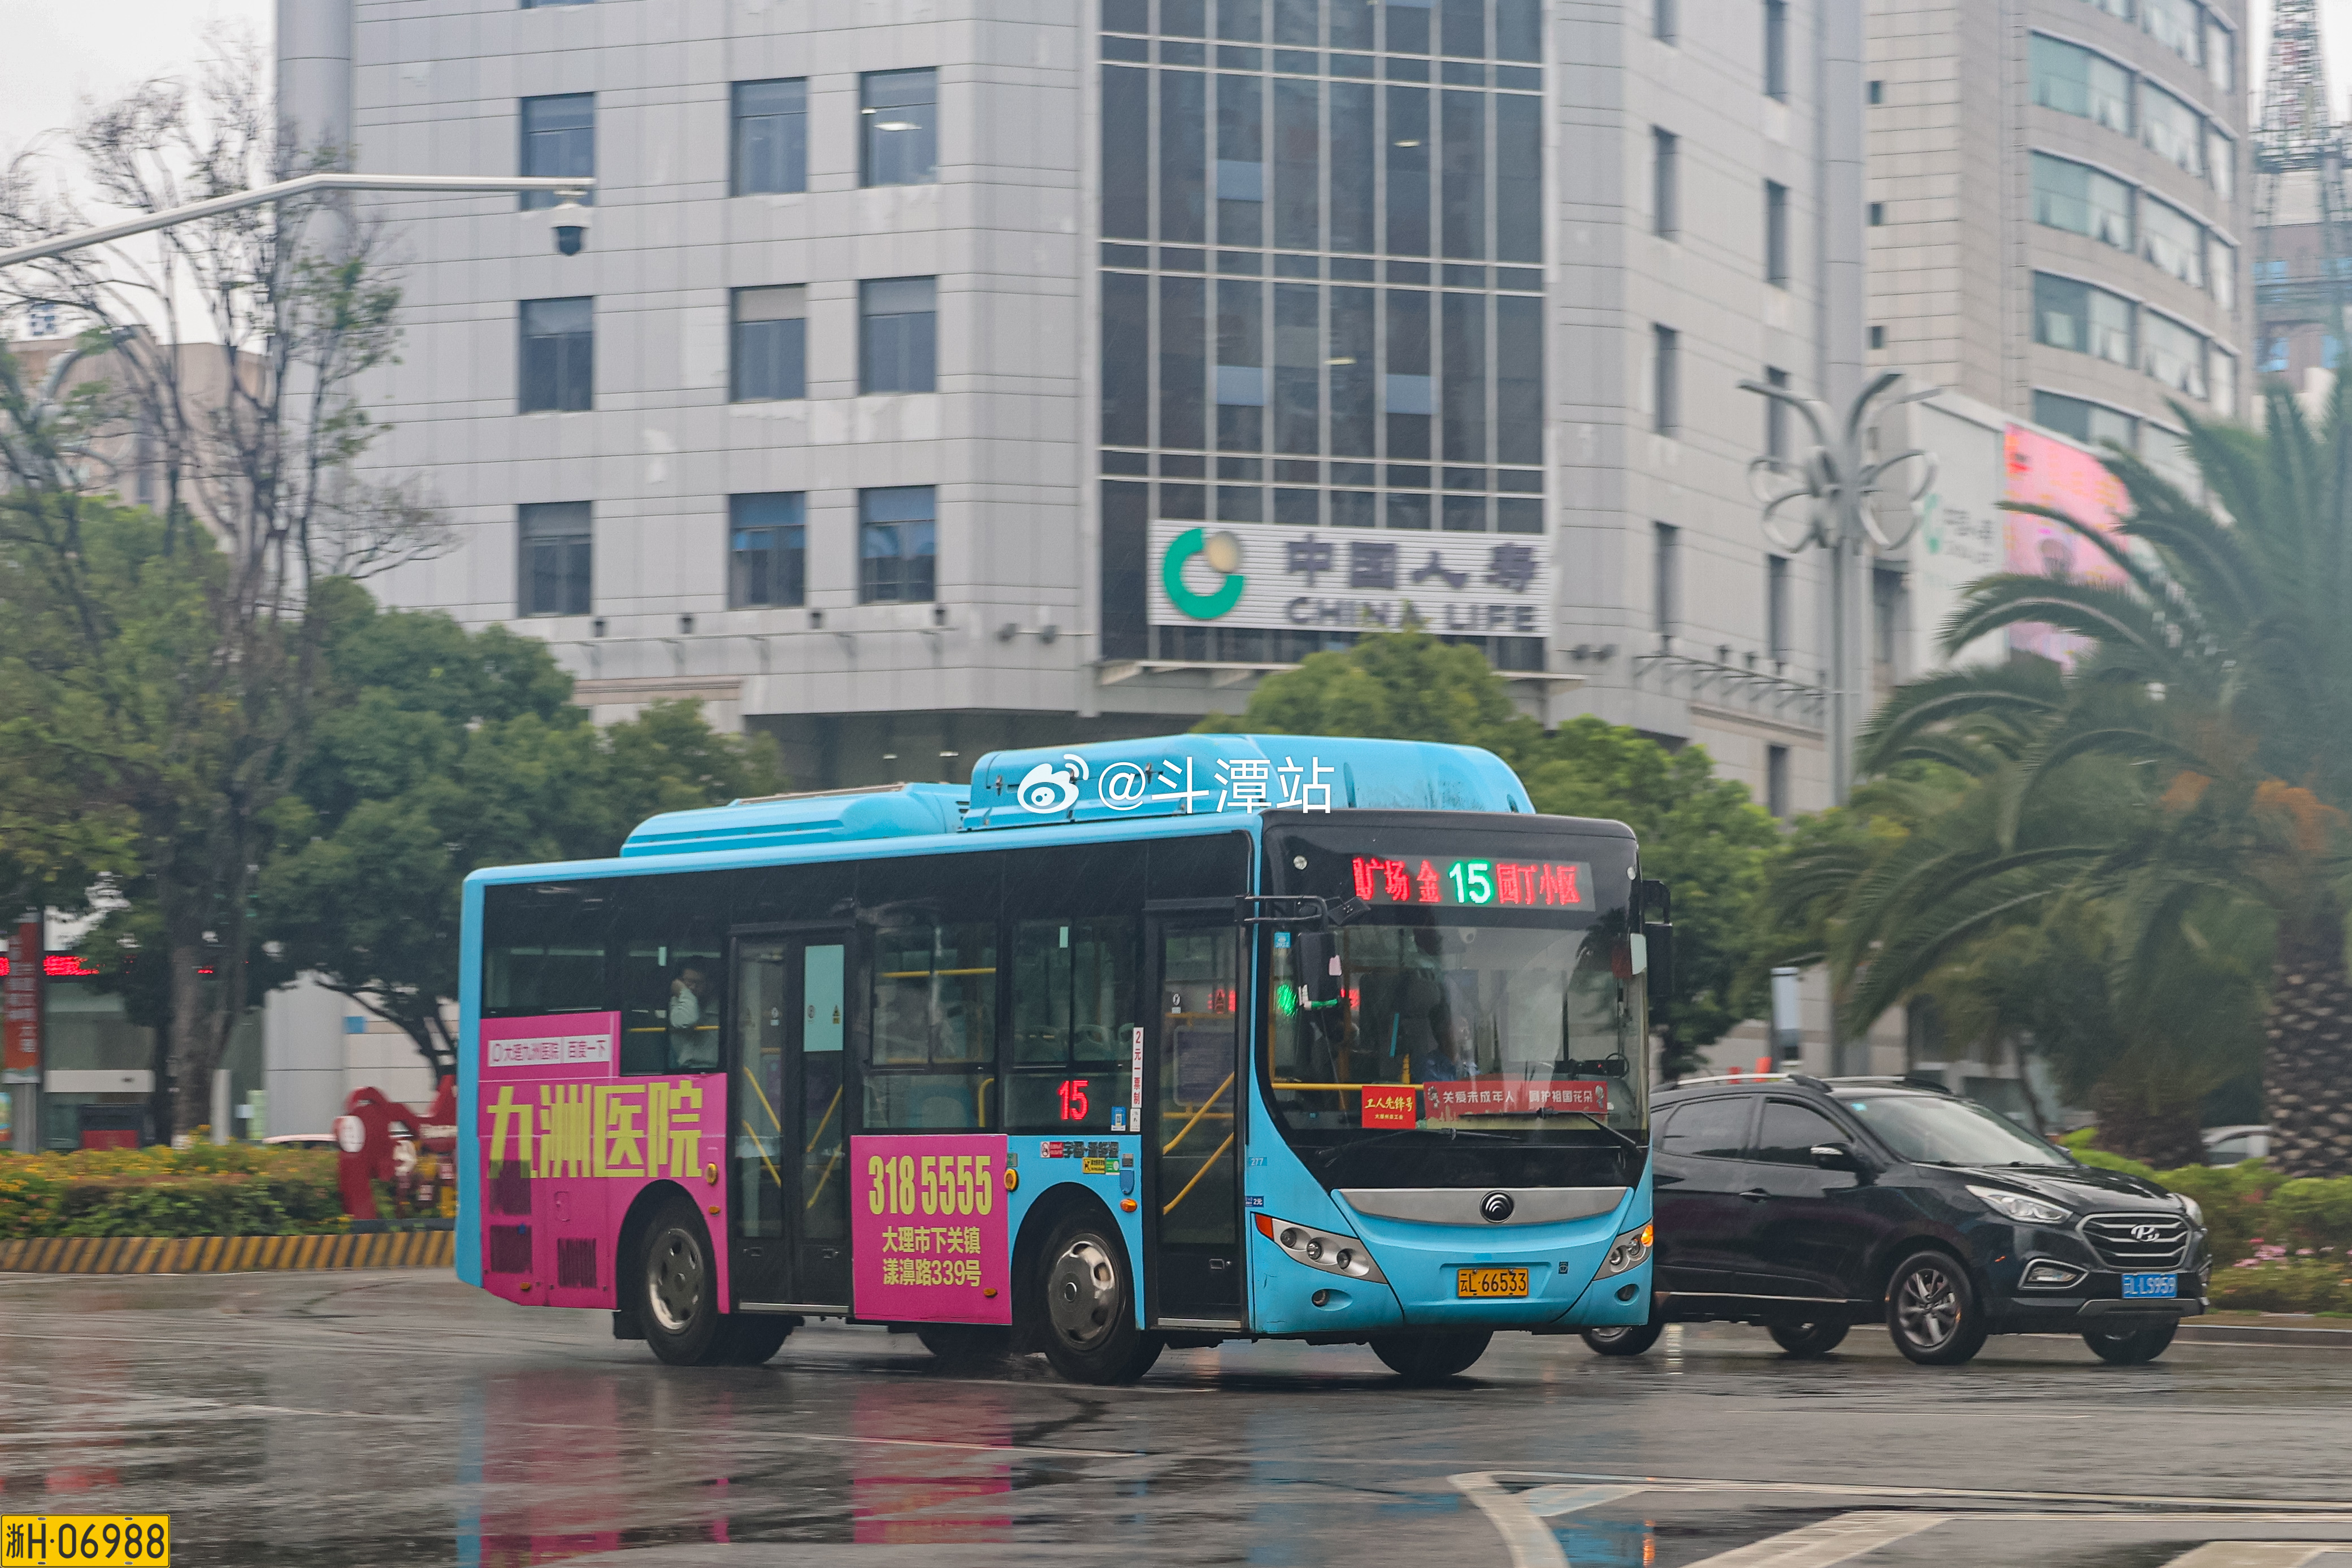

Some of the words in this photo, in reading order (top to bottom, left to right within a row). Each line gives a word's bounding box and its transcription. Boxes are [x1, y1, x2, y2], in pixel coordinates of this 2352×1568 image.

[1286, 533, 1538, 592] 中国人寿
[1445, 604, 1533, 631] LIFE
[1450, 862, 1492, 904] 15
[1057, 1080, 1088, 1120] 15
[1365, 1096, 1412, 1112] 工人先锋号
[1443, 1091, 1515, 1104] 关爱未成年人
[1529, 1089, 1593, 1103] 呵护祖国花朵
[487, 1080, 702, 1178] 九洲医院
[869, 1156, 915, 1215] 318
[921, 1156, 993, 1215] 5555
[882, 1226, 980, 1254] 大理市下关镇
[883, 1258, 982, 1287] 漾濞路339号
